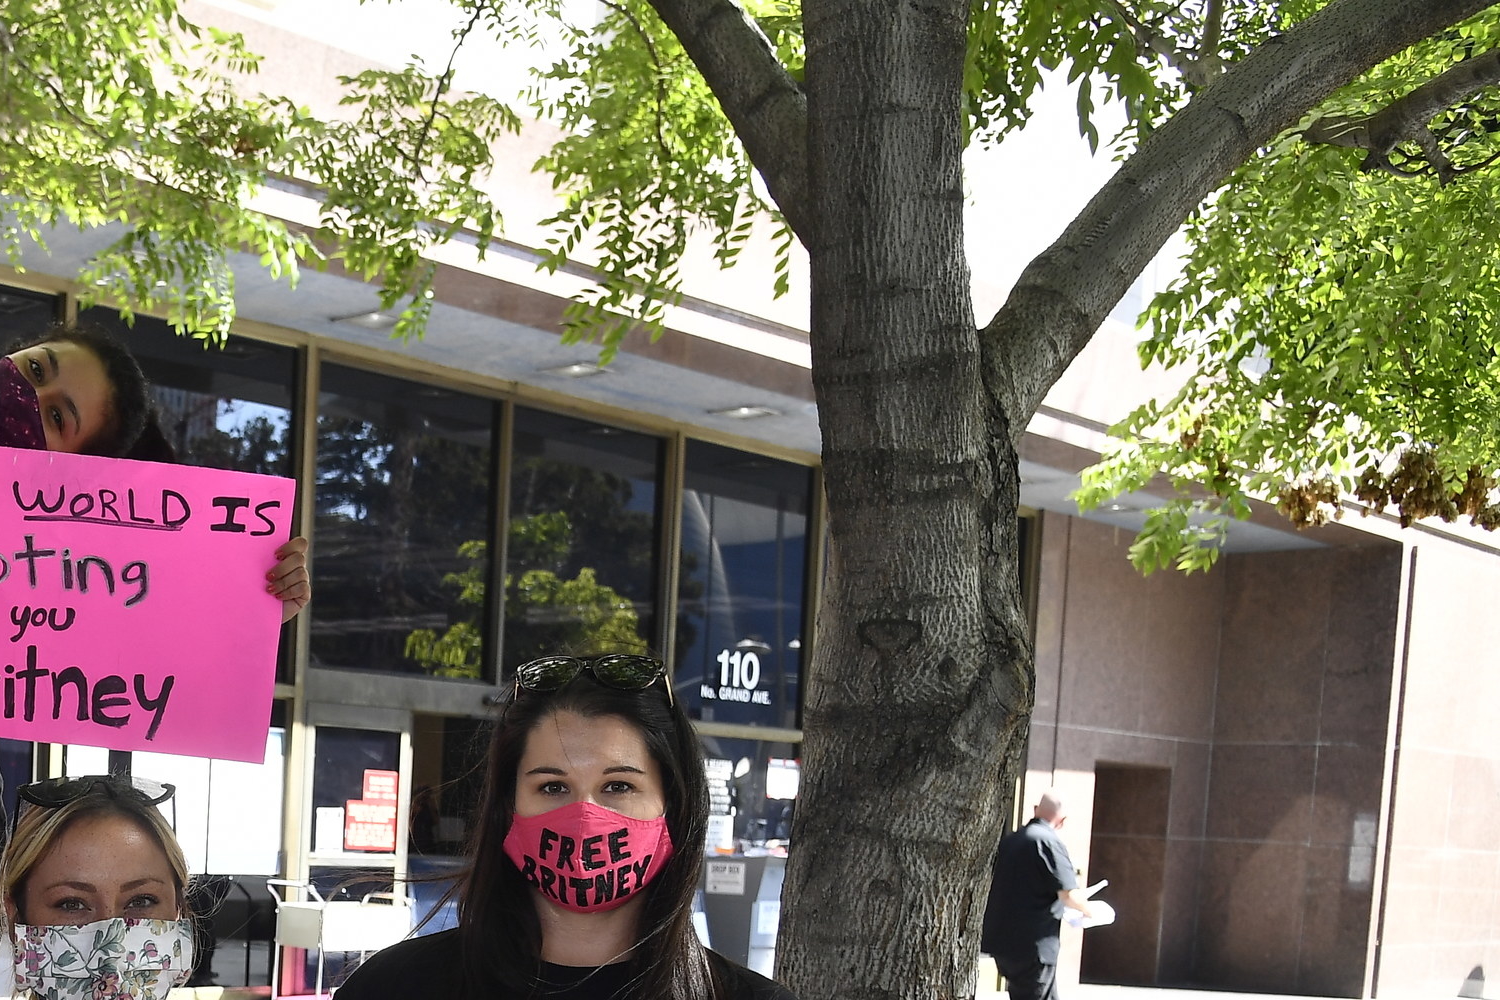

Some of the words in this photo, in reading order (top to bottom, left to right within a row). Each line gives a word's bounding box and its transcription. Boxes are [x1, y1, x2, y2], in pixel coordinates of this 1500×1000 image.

[11, 480, 192, 529] WORLD
[210, 496, 282, 537] IS
[9, 604, 77, 643] you
[716, 649, 760, 690] 110
[718, 686, 751, 703] GRAND
[752, 690, 772, 705] AVE.
[539, 827, 632, 872] FREE
[521, 854, 653, 907] BRITNEY
